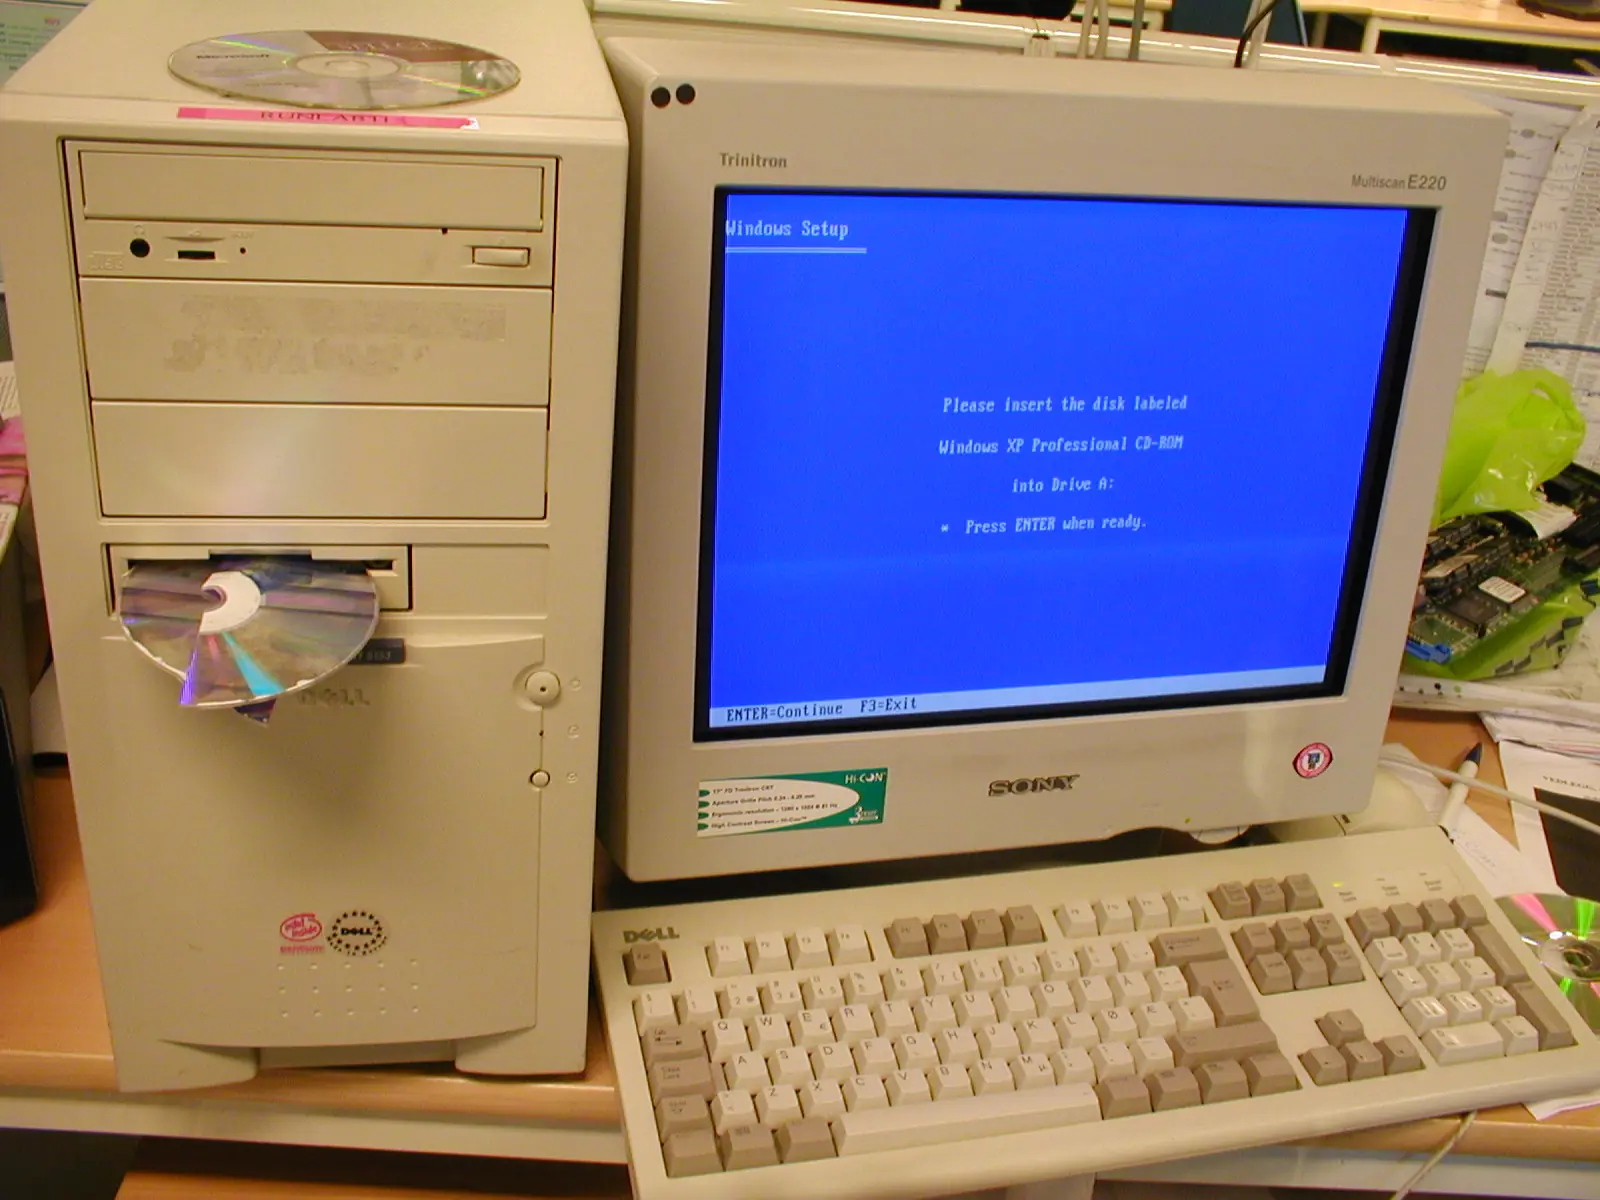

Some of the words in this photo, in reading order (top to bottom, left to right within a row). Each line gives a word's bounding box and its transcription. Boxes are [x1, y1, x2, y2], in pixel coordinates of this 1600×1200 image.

[719, 152, 788, 169] Trinitron
[1351, 174, 1405, 189] Multiscan
[1407, 173, 1448, 191] E220
[725, 220, 792, 236] Windows
[801, 219, 849, 240] Setup
[943, 397, 995, 413] Please
[1004, 397, 1053, 412] insert
[1061, 396, 1085, 411] the
[1092, 396, 1125, 411] disk
[1134, 395, 1188, 410] labeled
[938, 440, 998, 455] Windows
[1006, 438, 1024, 453] XP
[1031, 436, 1127, 453] Professional
[1135, 435, 1184, 450] CD-ROM
[1012, 478, 1044, 493] into
[1051, 476, 1091, 492] Drive
[1099, 476, 1114, 490] A:
[965, 519, 1007, 534] Press
[1015, 516, 1056, 532] ENTER
[1062, 515, 1095, 530] when
[1101, 513, 1147, 532] ready.
[727, 703, 843, 722] ENTER=Continue
[860, 697, 917, 713] F3=Exit
[987, 773, 1081, 797] SONY
[340, 927, 373, 936] DELL
[622, 926, 680, 944] DELL
[759, 1016, 773, 1026] W
